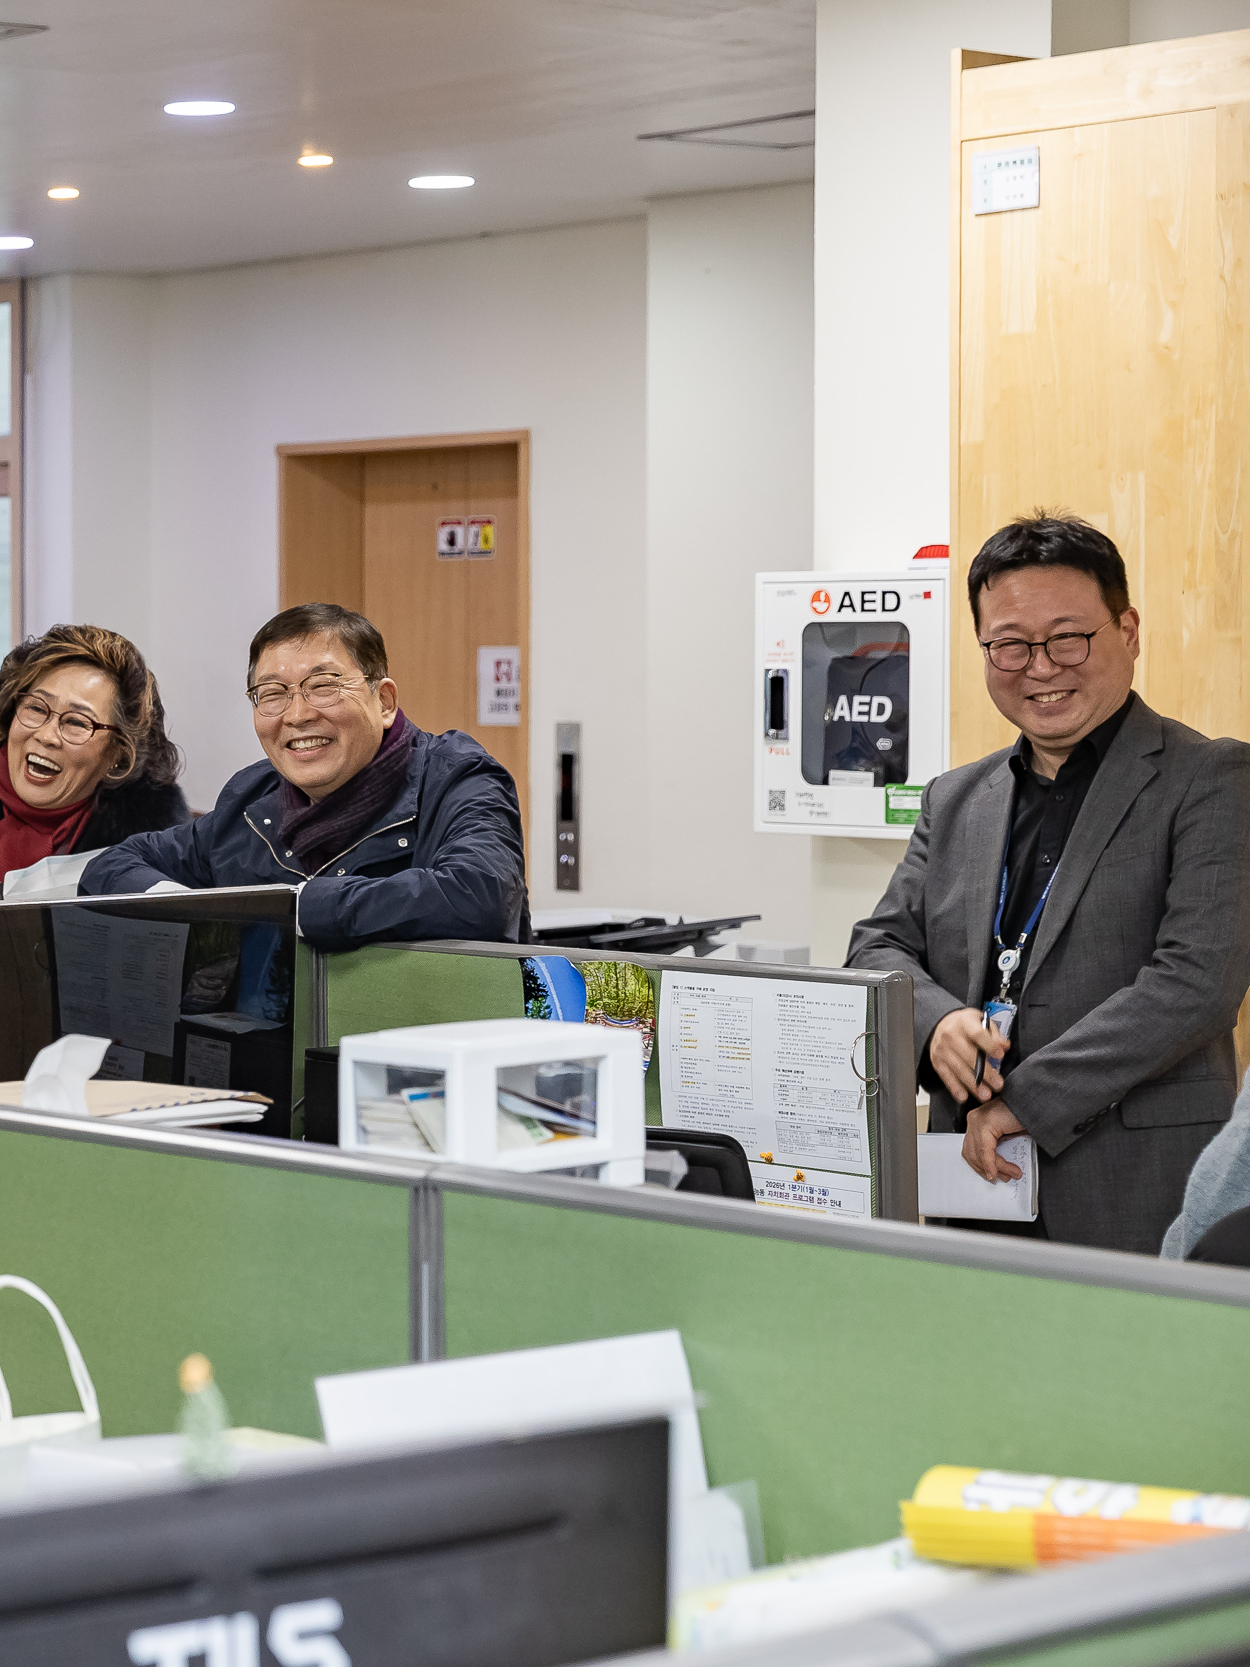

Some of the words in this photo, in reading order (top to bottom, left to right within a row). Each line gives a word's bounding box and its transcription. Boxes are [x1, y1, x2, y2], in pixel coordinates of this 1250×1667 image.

[837, 590, 901, 613] AED
[832, 694, 893, 723] AED
[768, 747, 790, 756] PULL
[765, 1181, 785, 1190] 2026년
[767, 1190, 790, 1200] 자치회관
[793, 1193, 815, 1203] 프로그램
[817, 1197, 828, 1205] 접수
[830, 1199, 842, 1208] 안내
